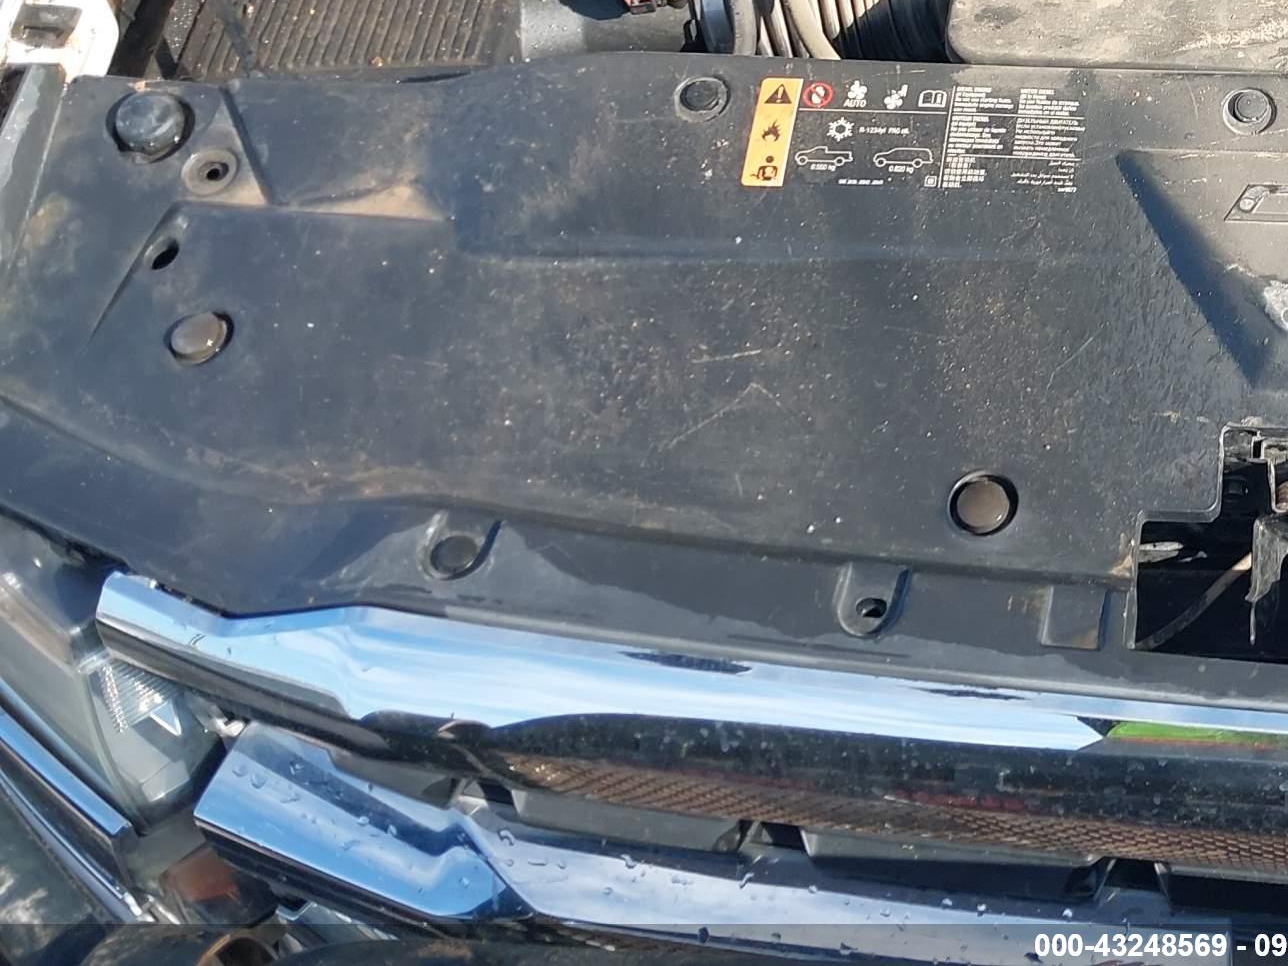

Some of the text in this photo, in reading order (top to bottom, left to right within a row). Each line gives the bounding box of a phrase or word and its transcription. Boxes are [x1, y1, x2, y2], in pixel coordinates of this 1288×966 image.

[843, 99, 867, 108] AUTO
[828, 164, 837, 172] kg
[906, 166, 914, 174] kg
